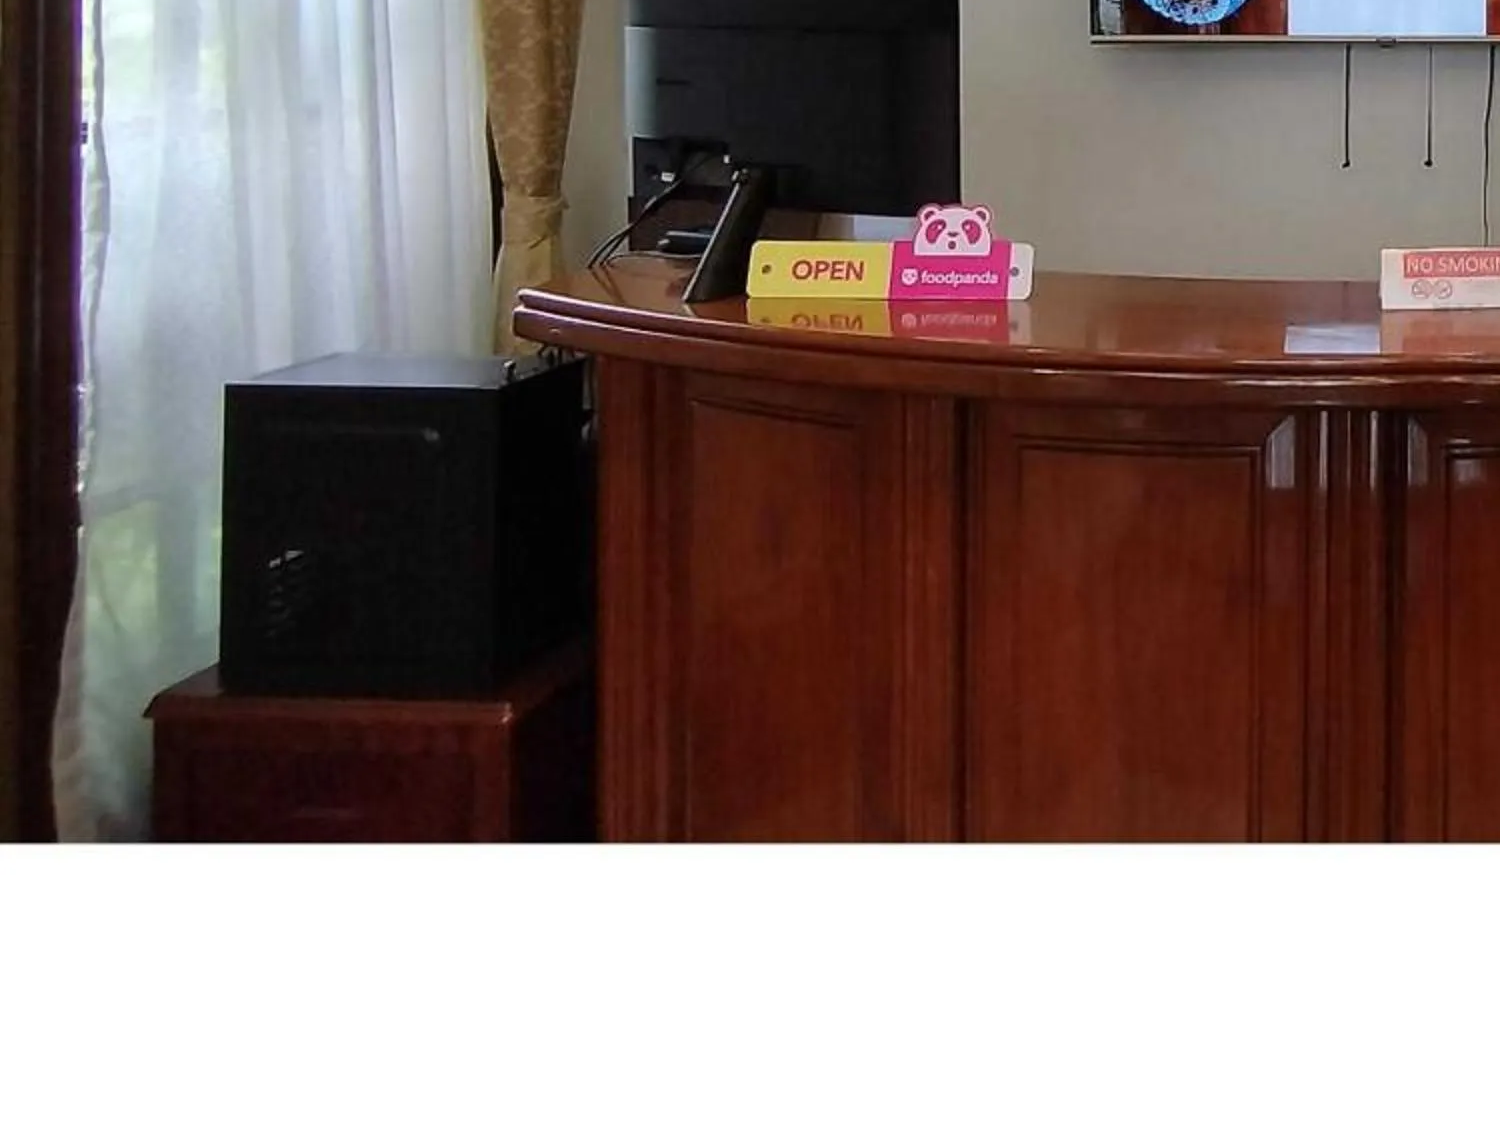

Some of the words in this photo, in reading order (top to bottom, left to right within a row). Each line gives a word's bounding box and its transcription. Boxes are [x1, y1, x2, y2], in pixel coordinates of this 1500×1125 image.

[791, 260, 865, 282] OPEN
[1406, 257, 1433, 274] NO
[920, 270, 999, 288] foodpanda
